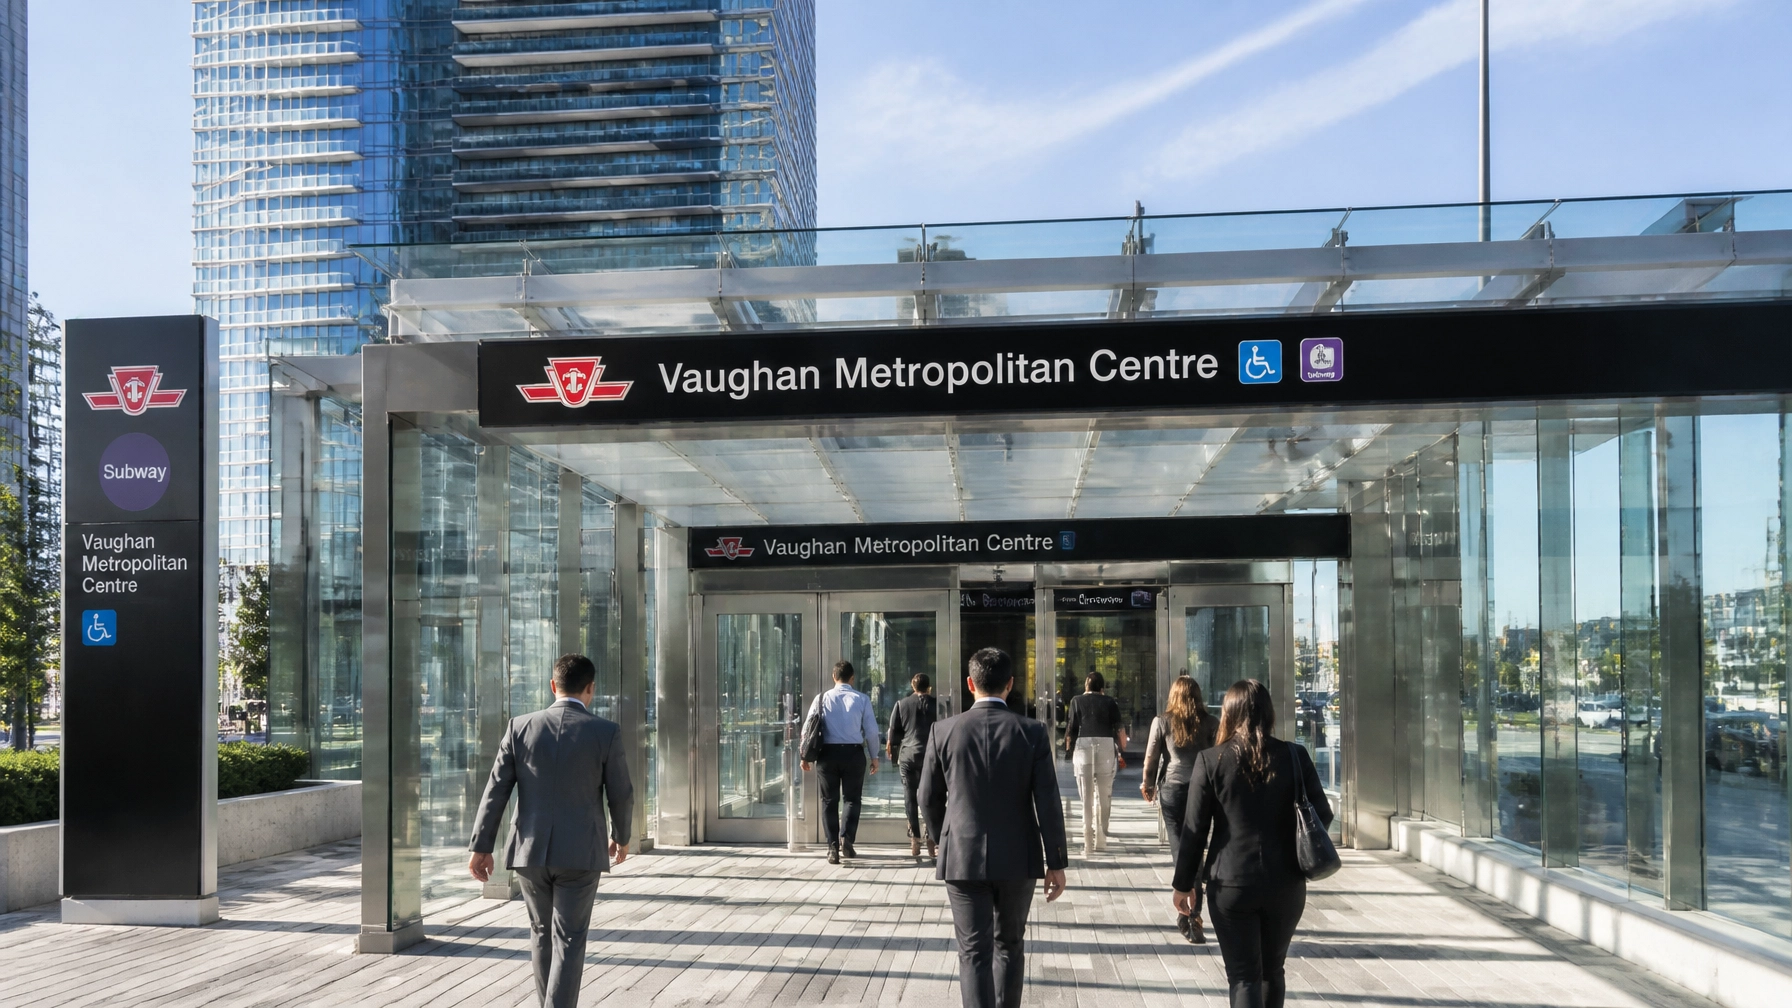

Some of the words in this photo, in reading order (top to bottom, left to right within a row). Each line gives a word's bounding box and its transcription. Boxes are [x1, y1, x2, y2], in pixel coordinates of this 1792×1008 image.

[657, 360, 820, 400] Vaughan
[835, 352, 1075, 395] Metropolitan
[1089, 348, 1219, 382] Centre
[103, 463, 167, 483] Subway
[81, 532, 155, 554] Vaughan
[763, 537, 847, 560] Vaughan
[854, 534, 979, 557] Metropolitan
[986, 533, 1054, 551] Centre
[82, 554, 188, 574] Metropolitan
[82, 577, 138, 594] Centre
